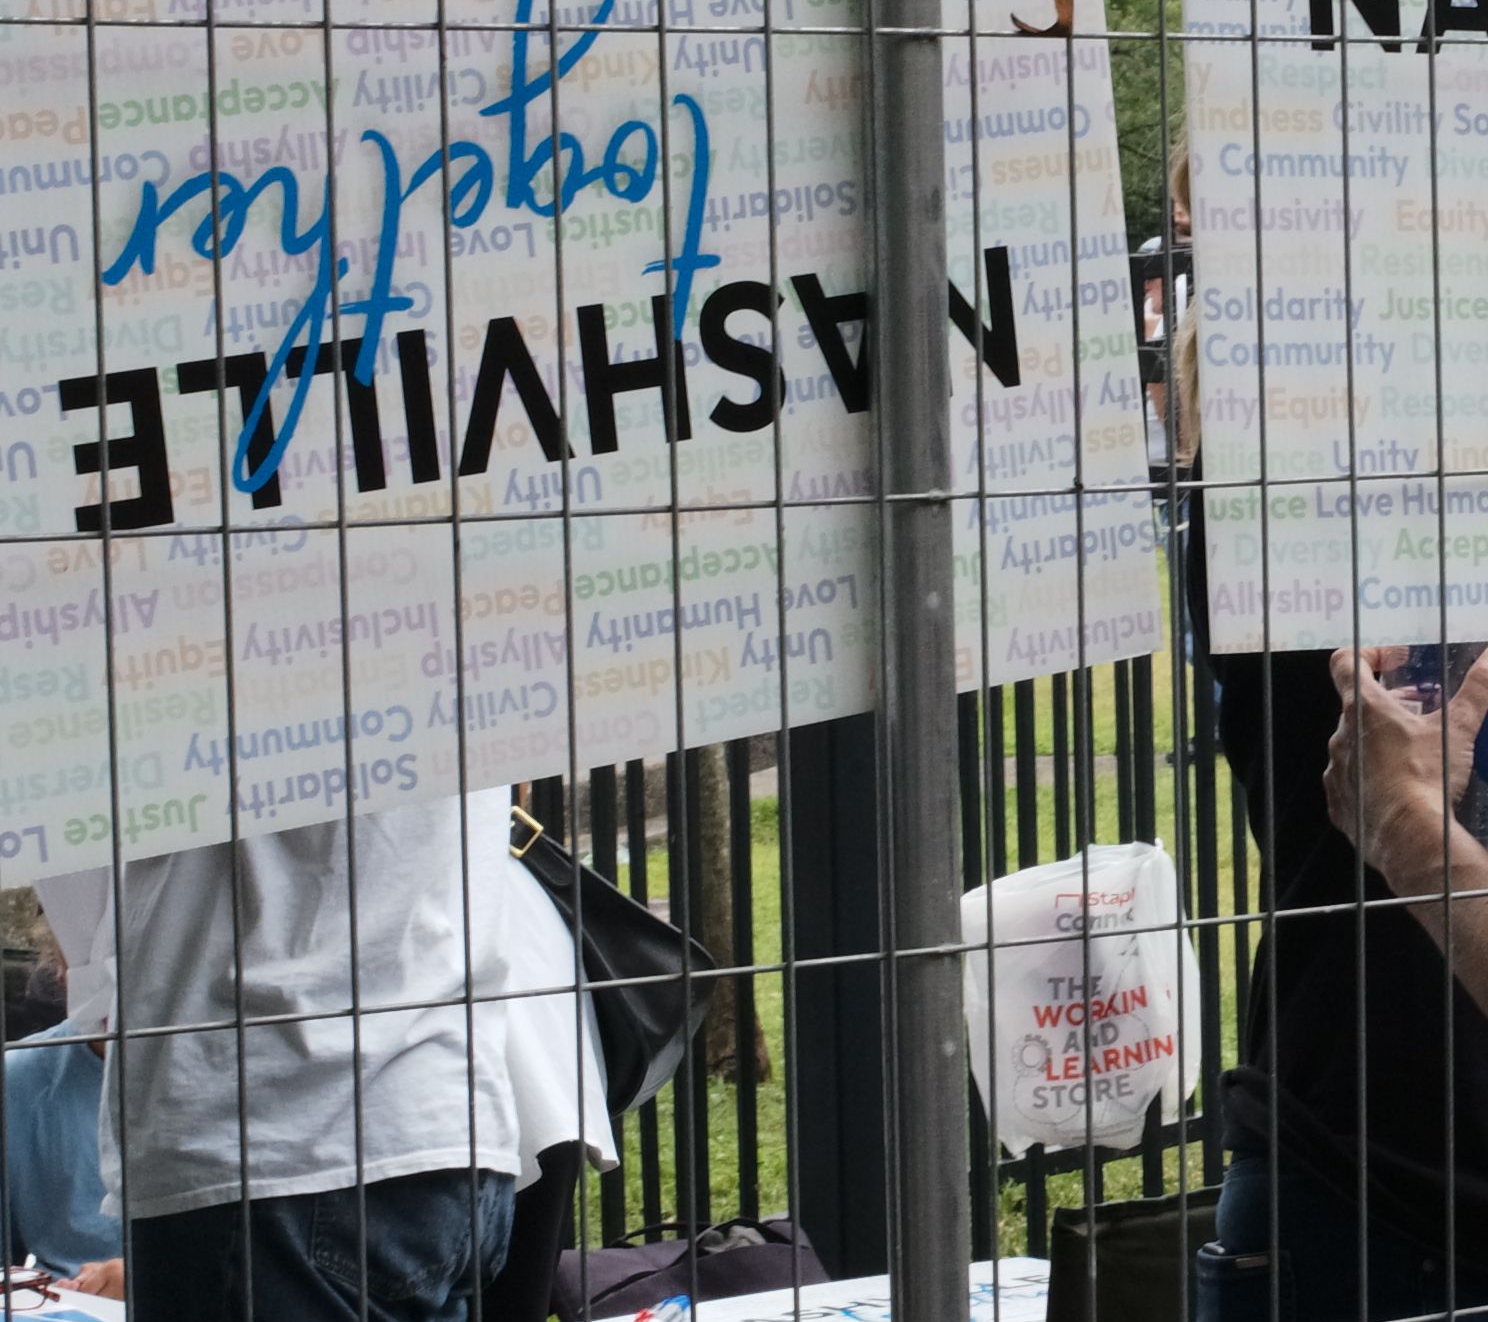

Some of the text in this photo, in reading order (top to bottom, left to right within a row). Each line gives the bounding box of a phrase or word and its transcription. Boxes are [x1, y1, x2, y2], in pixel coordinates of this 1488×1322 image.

[184, 704, 414, 774] Community
[64, 753, 419, 849] Solidarity Justice
[1048, 975, 1103, 1001] THE
[1032, 1073, 1135, 1110] STORE
